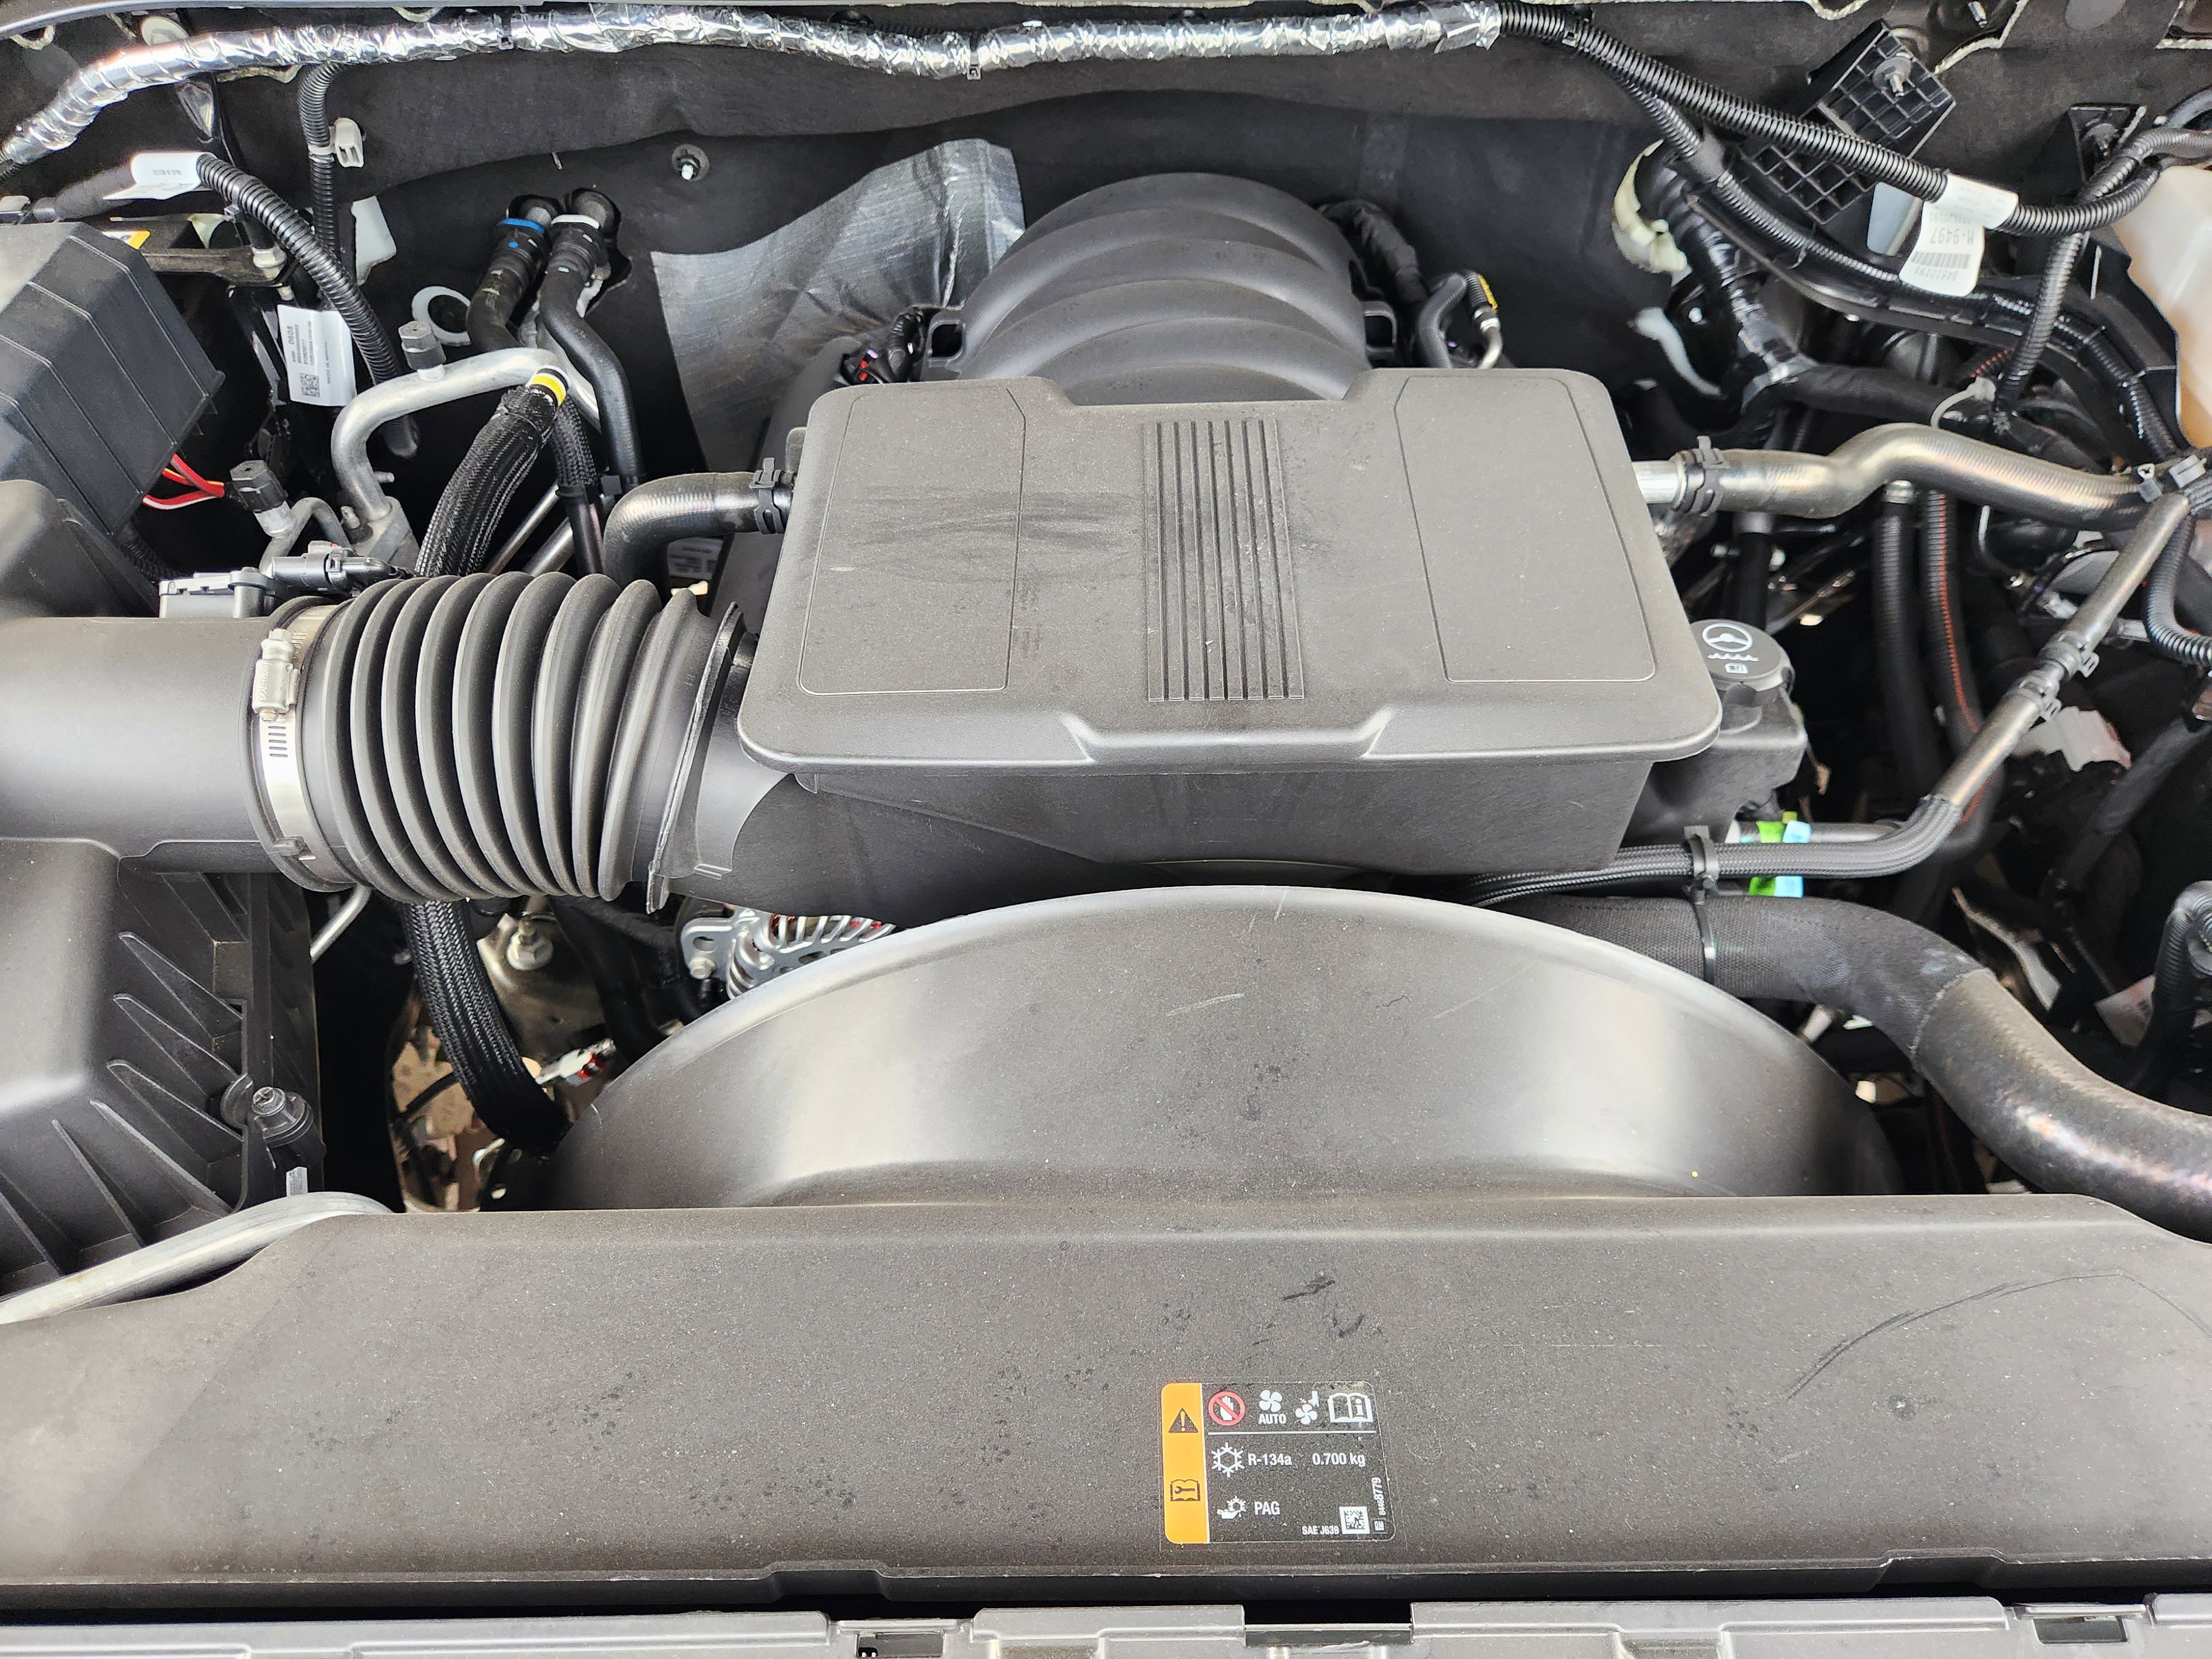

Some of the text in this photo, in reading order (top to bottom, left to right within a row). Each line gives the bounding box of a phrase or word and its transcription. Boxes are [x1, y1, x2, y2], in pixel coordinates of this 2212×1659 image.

[1929, 227, 1974, 245] M-9497
[1258, 1413, 1287, 1425] AUTO
[1248, 1452, 1366, 1467] R-134a 0.700 kg
[1254, 1501, 1281, 1515] PAG
[1302, 1524, 1340, 1535] SAE J639
